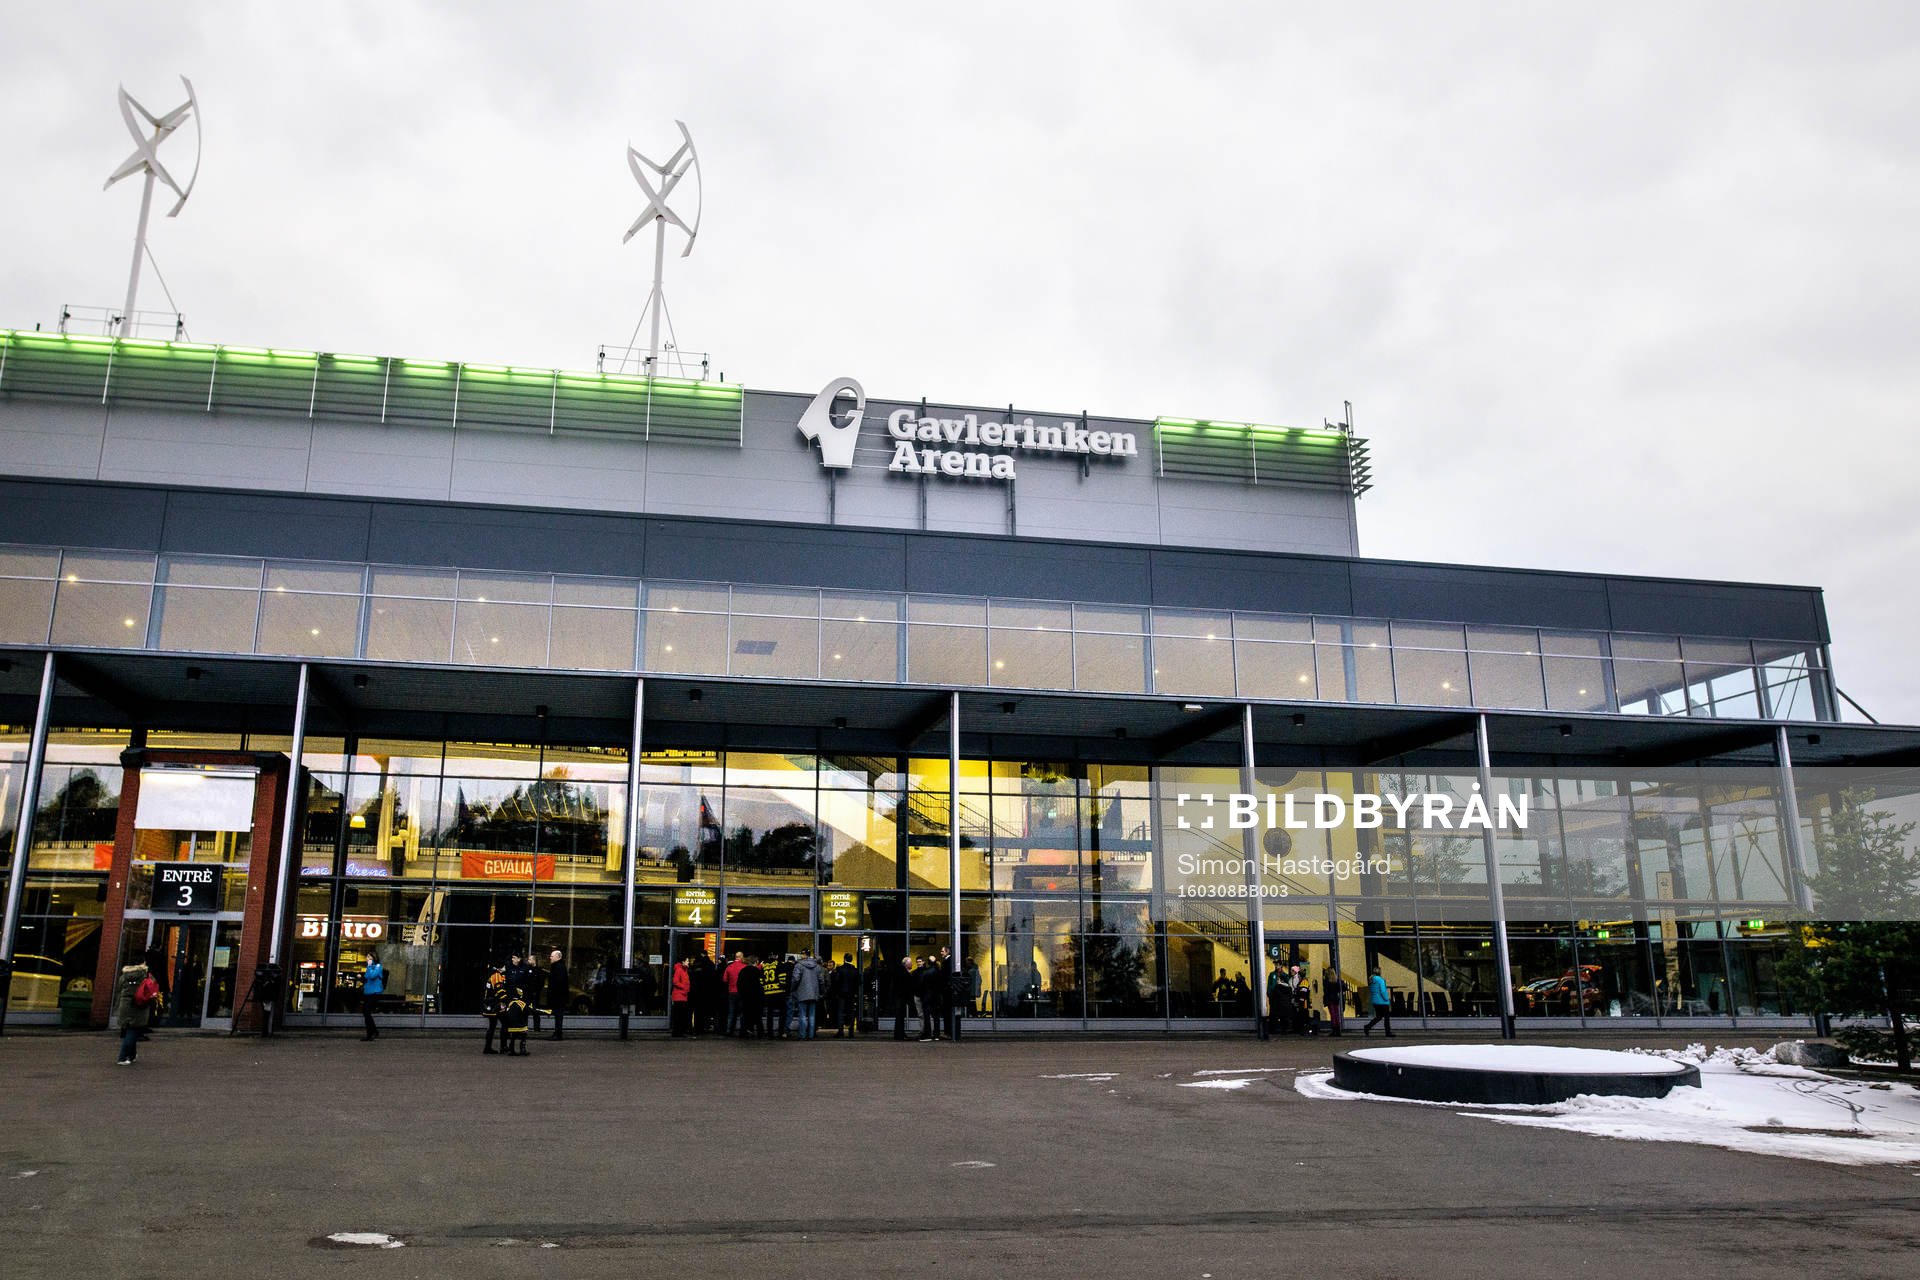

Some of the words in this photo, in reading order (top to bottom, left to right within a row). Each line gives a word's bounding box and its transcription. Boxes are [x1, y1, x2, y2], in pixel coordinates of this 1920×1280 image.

[888, 409, 1138, 456] Gavlerinken
[888, 440, 1017, 480] Arena
[484, 860, 533, 875] GEVALIA
[177, 885, 193, 907] 3
[688, 906, 702, 925] 4
[834, 909, 847, 927] 5
[302, 917, 382, 938] Bitro
[1271, 946, 1279, 956] 6
